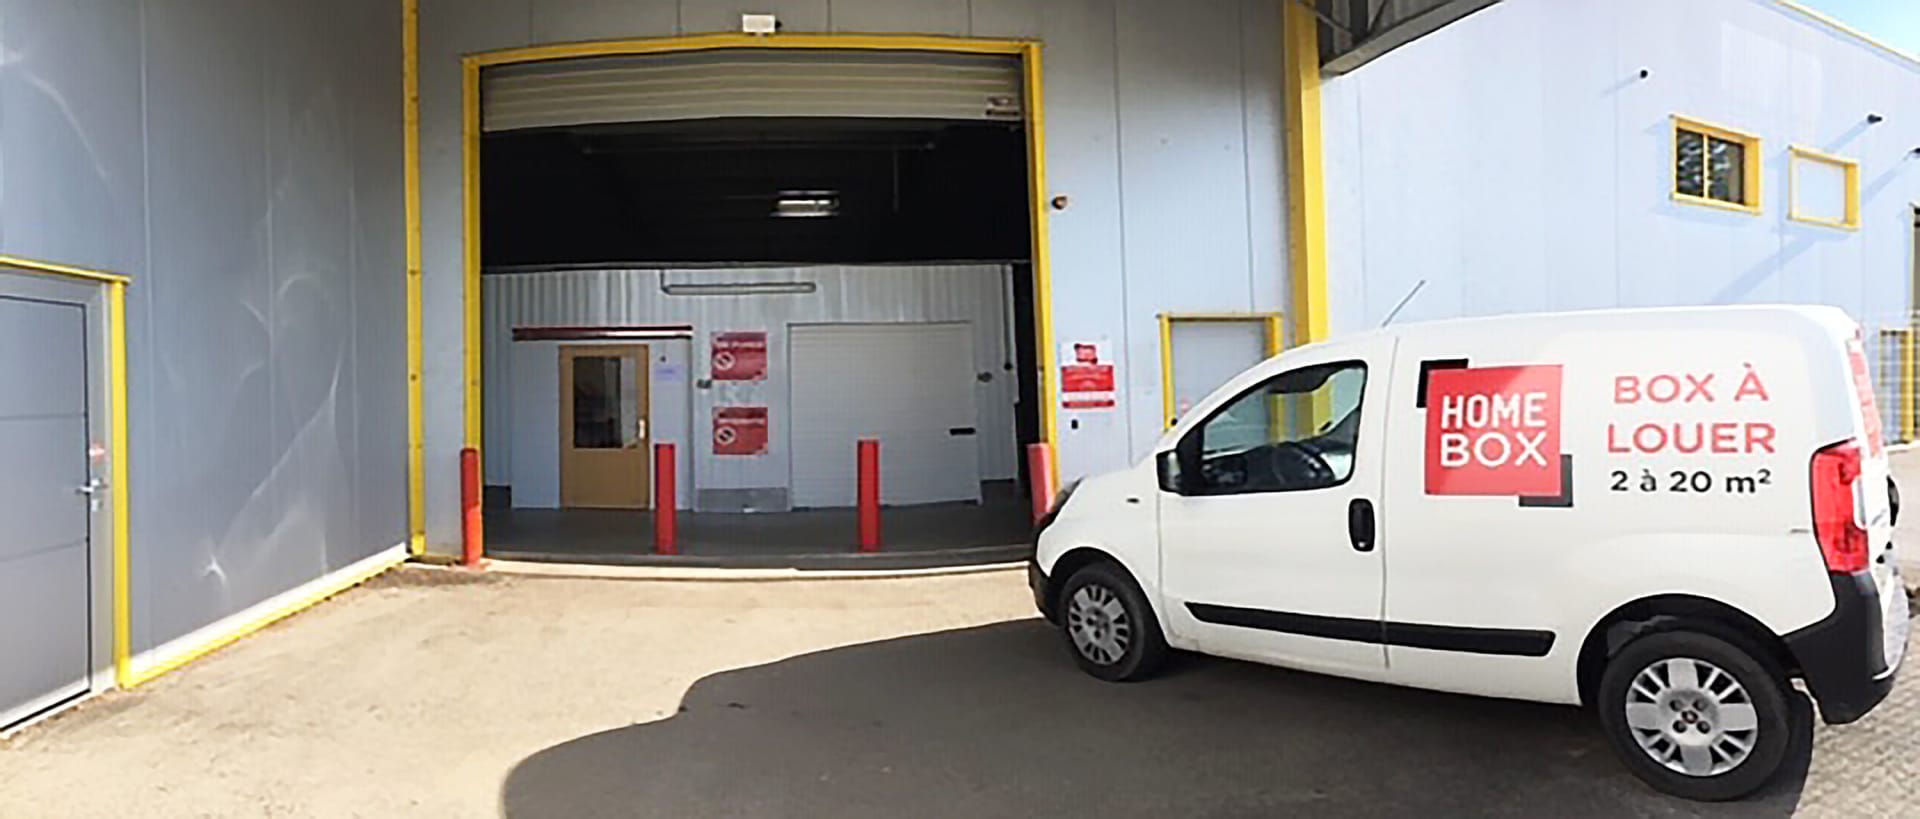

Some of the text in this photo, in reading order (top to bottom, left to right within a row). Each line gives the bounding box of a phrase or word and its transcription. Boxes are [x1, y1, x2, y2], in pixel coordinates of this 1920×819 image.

[1613, 363, 1769, 404] BOX À
[1440, 393, 1547, 428] HOME
[1440, 432, 1547, 467] BOX
[1608, 423, 1775, 453] LOUER
[1611, 469, 1772, 493] 2 à 20 m²
